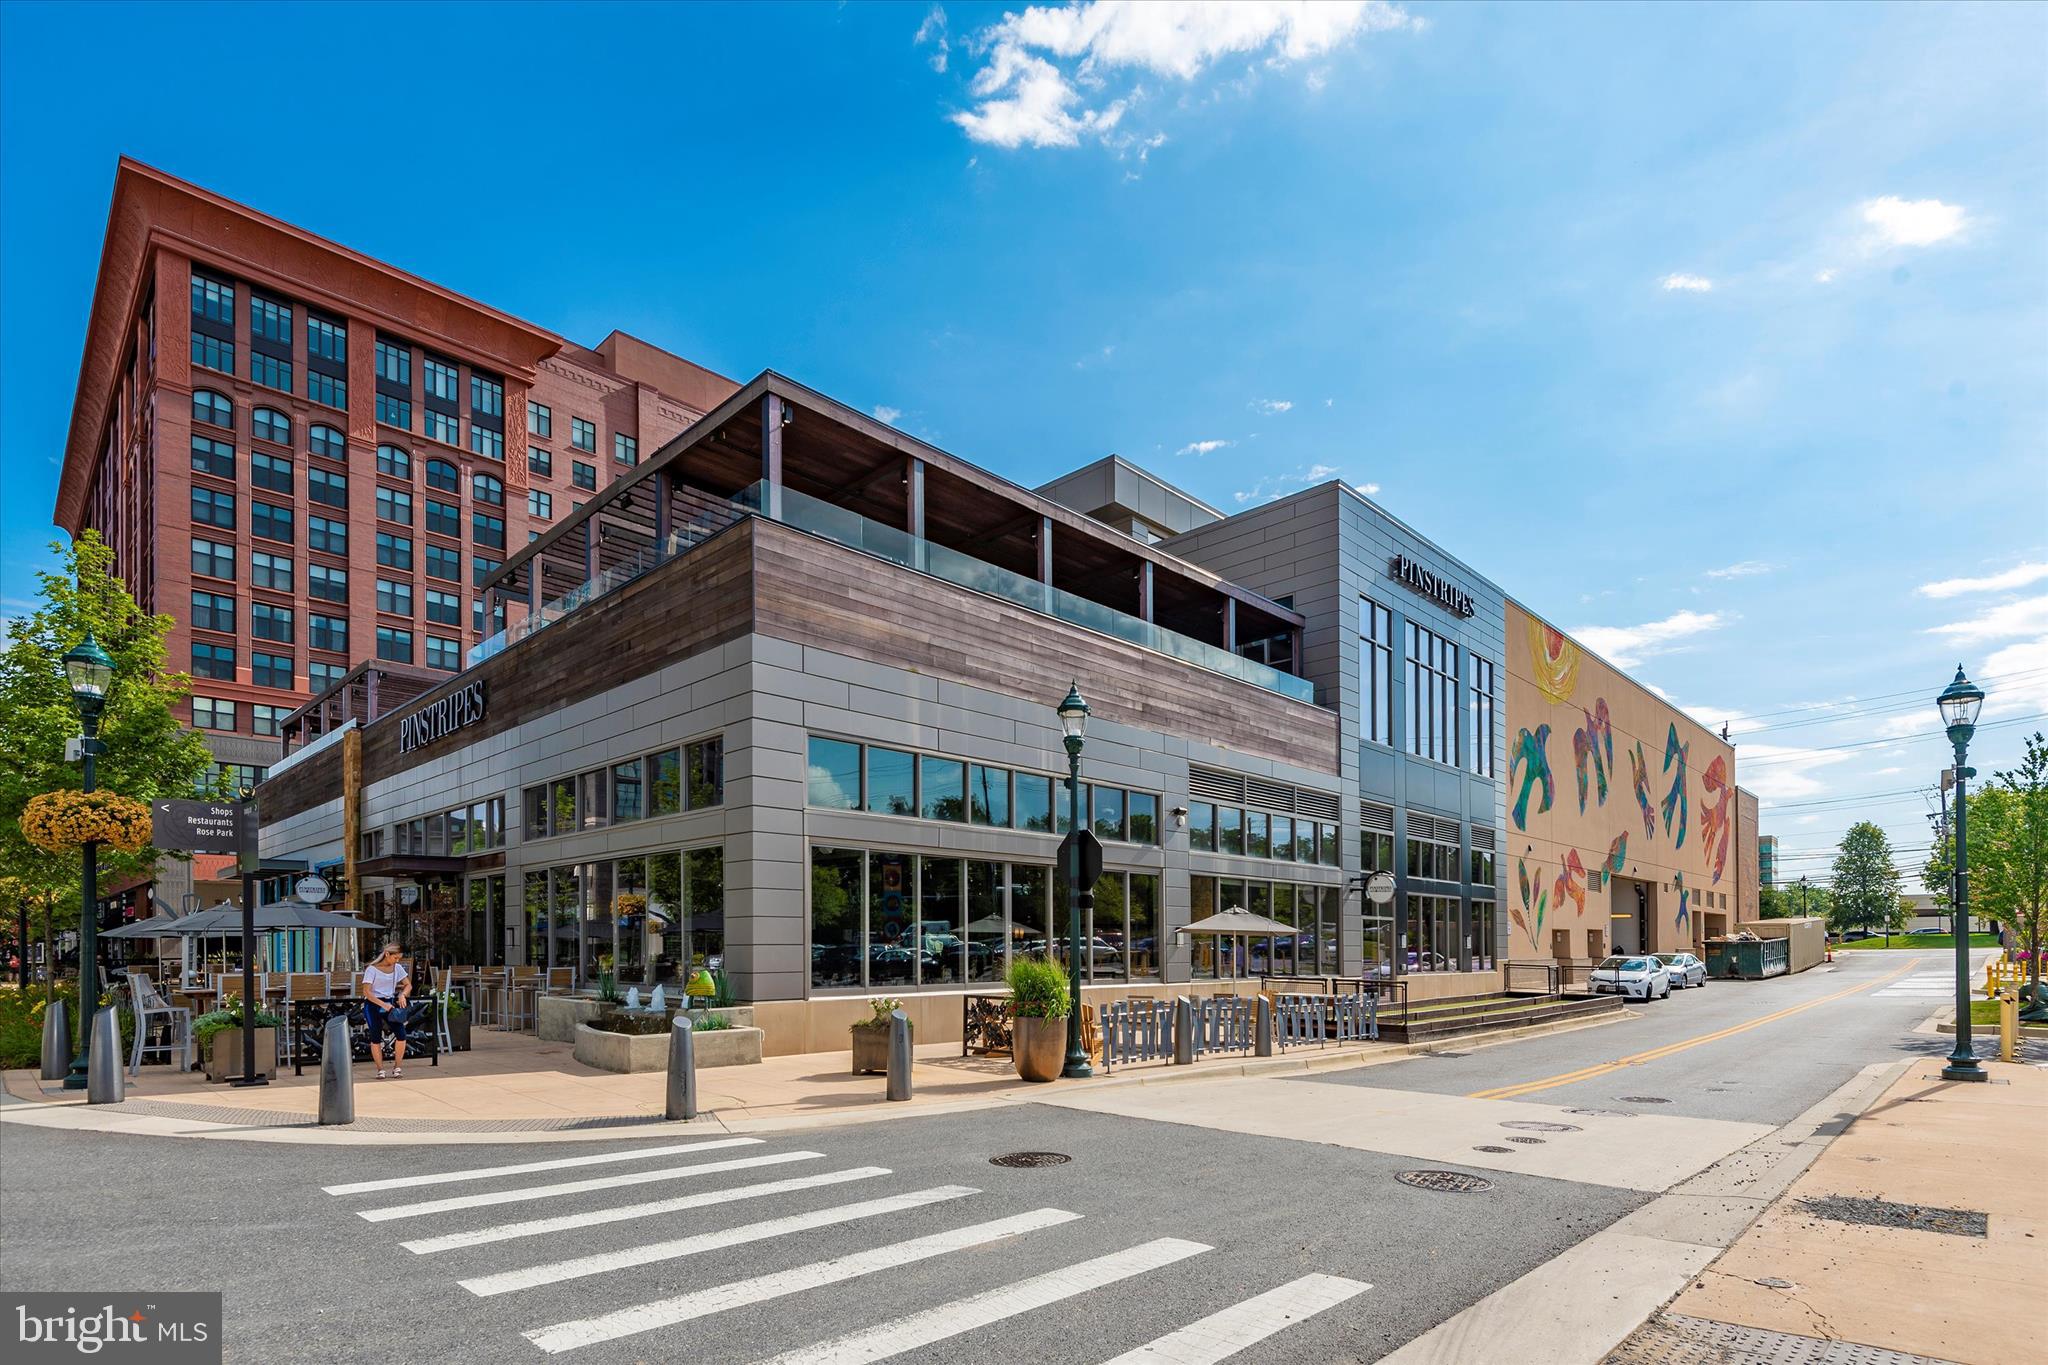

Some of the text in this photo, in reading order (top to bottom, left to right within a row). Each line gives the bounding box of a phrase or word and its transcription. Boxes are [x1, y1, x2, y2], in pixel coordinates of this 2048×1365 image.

[1398, 554, 1475, 618] PINSTRIPES
[400, 680, 484, 753] PINSTRIPES
[210, 807, 233, 816] Shops
[187, 816, 233, 827] Restaurants
[196, 828, 233, 837] Rose Park
